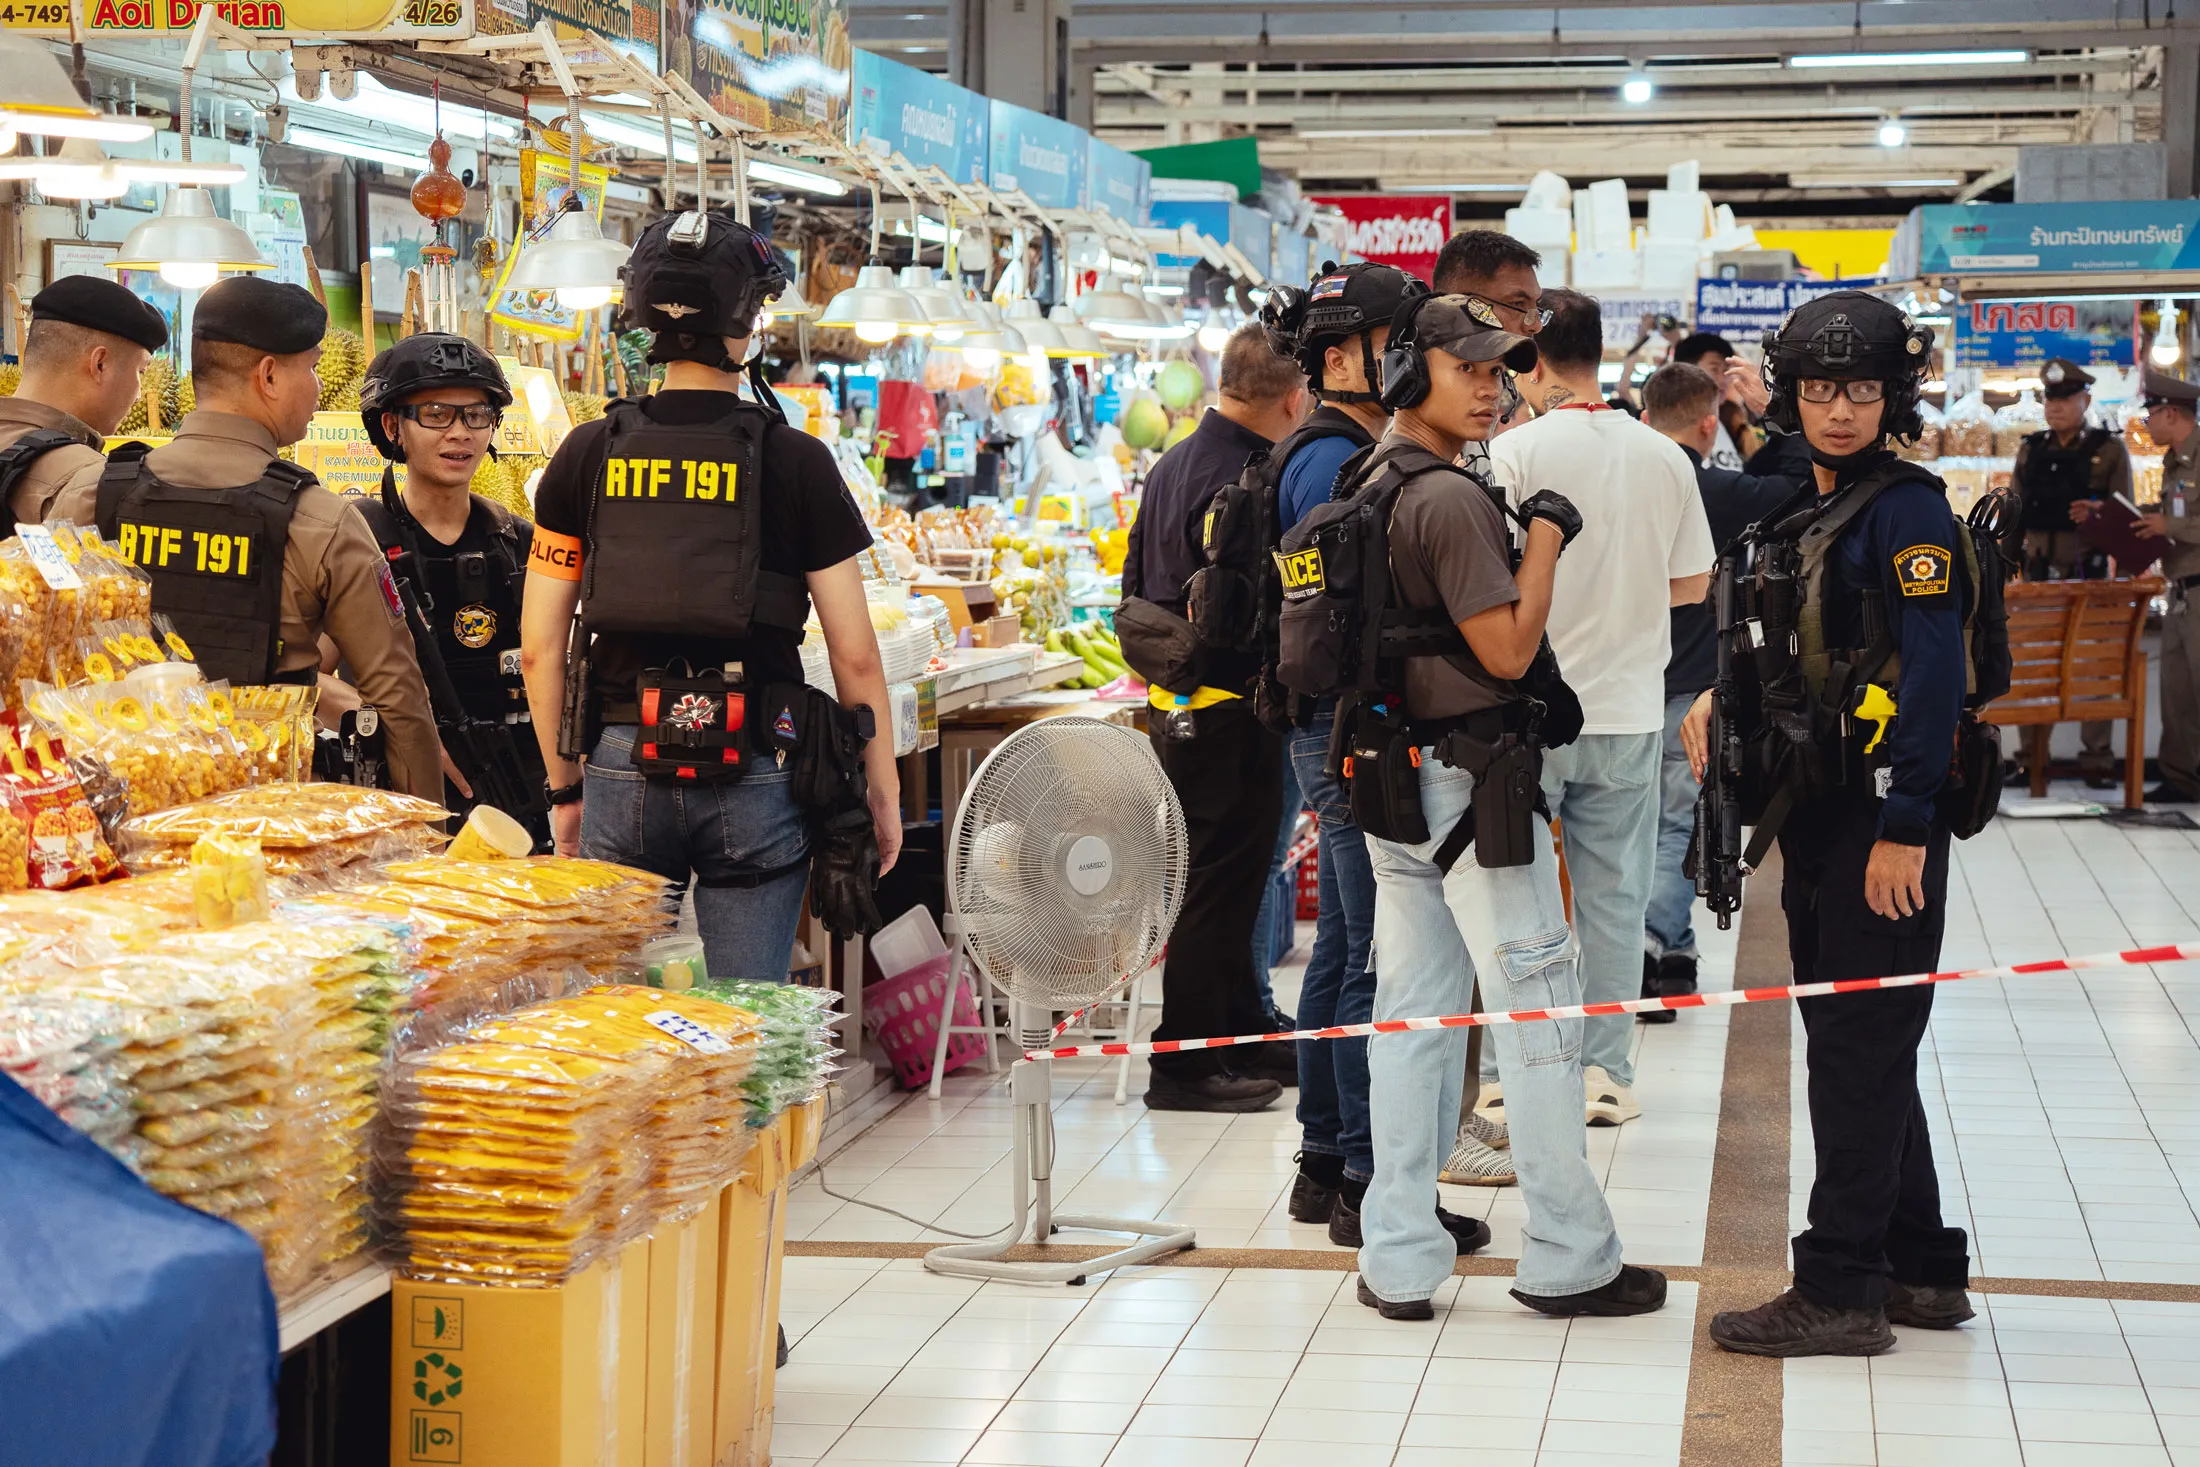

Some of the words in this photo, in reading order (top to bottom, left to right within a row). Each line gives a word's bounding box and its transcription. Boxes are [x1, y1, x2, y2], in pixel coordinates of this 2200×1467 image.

[92, 0, 154, 29] Aoi
[168, 0, 285, 30] Drian
[325, 456, 351, 466] KAN
[353, 456, 379, 466] YAO
[326, 472, 382, 482] PREMIUM
[606, 458, 671, 498] RTF
[682, 460, 737, 502] 191
[193, 532, 250, 575] 191
[1904, 579, 1946, 588] METROPOLITAN
[1912, 585, 1939, 593] POLICE
